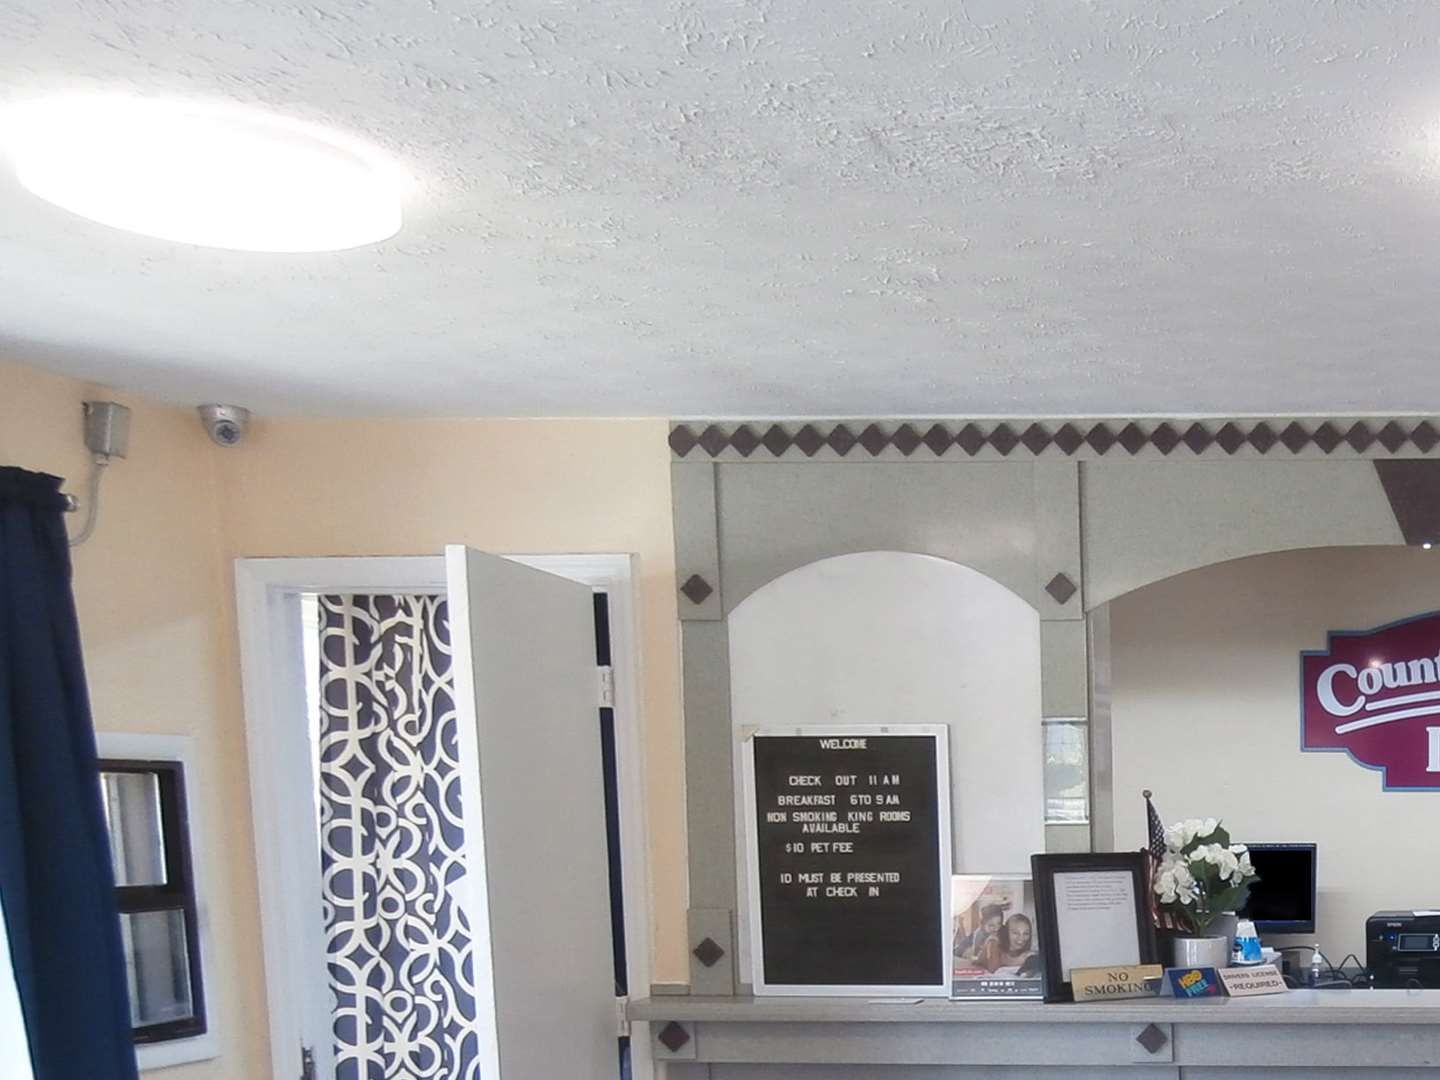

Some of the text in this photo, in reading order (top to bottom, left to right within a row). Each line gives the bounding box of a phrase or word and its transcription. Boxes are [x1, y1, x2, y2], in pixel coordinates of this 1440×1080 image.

[820, 739, 867, 750] WELCOME
[789, 775, 822, 786] CHECK
[835, 775, 857, 786] OUT
[778, 795, 836, 806] BREAKFAST
[767, 811, 911, 822] NON SMOKING KING ROOMS
[802, 823, 860, 834] AVAILABLE
[811, 842, 830, 853] PET
[832, 842, 854, 853] FEE
[798, 872, 824, 883] MUST
[830, 872, 842, 883] BE
[847, 872, 900, 883] PRESENTED
[806, 886, 880, 897] AT CHECK IN
[1107, 971, 1129, 982] NO
